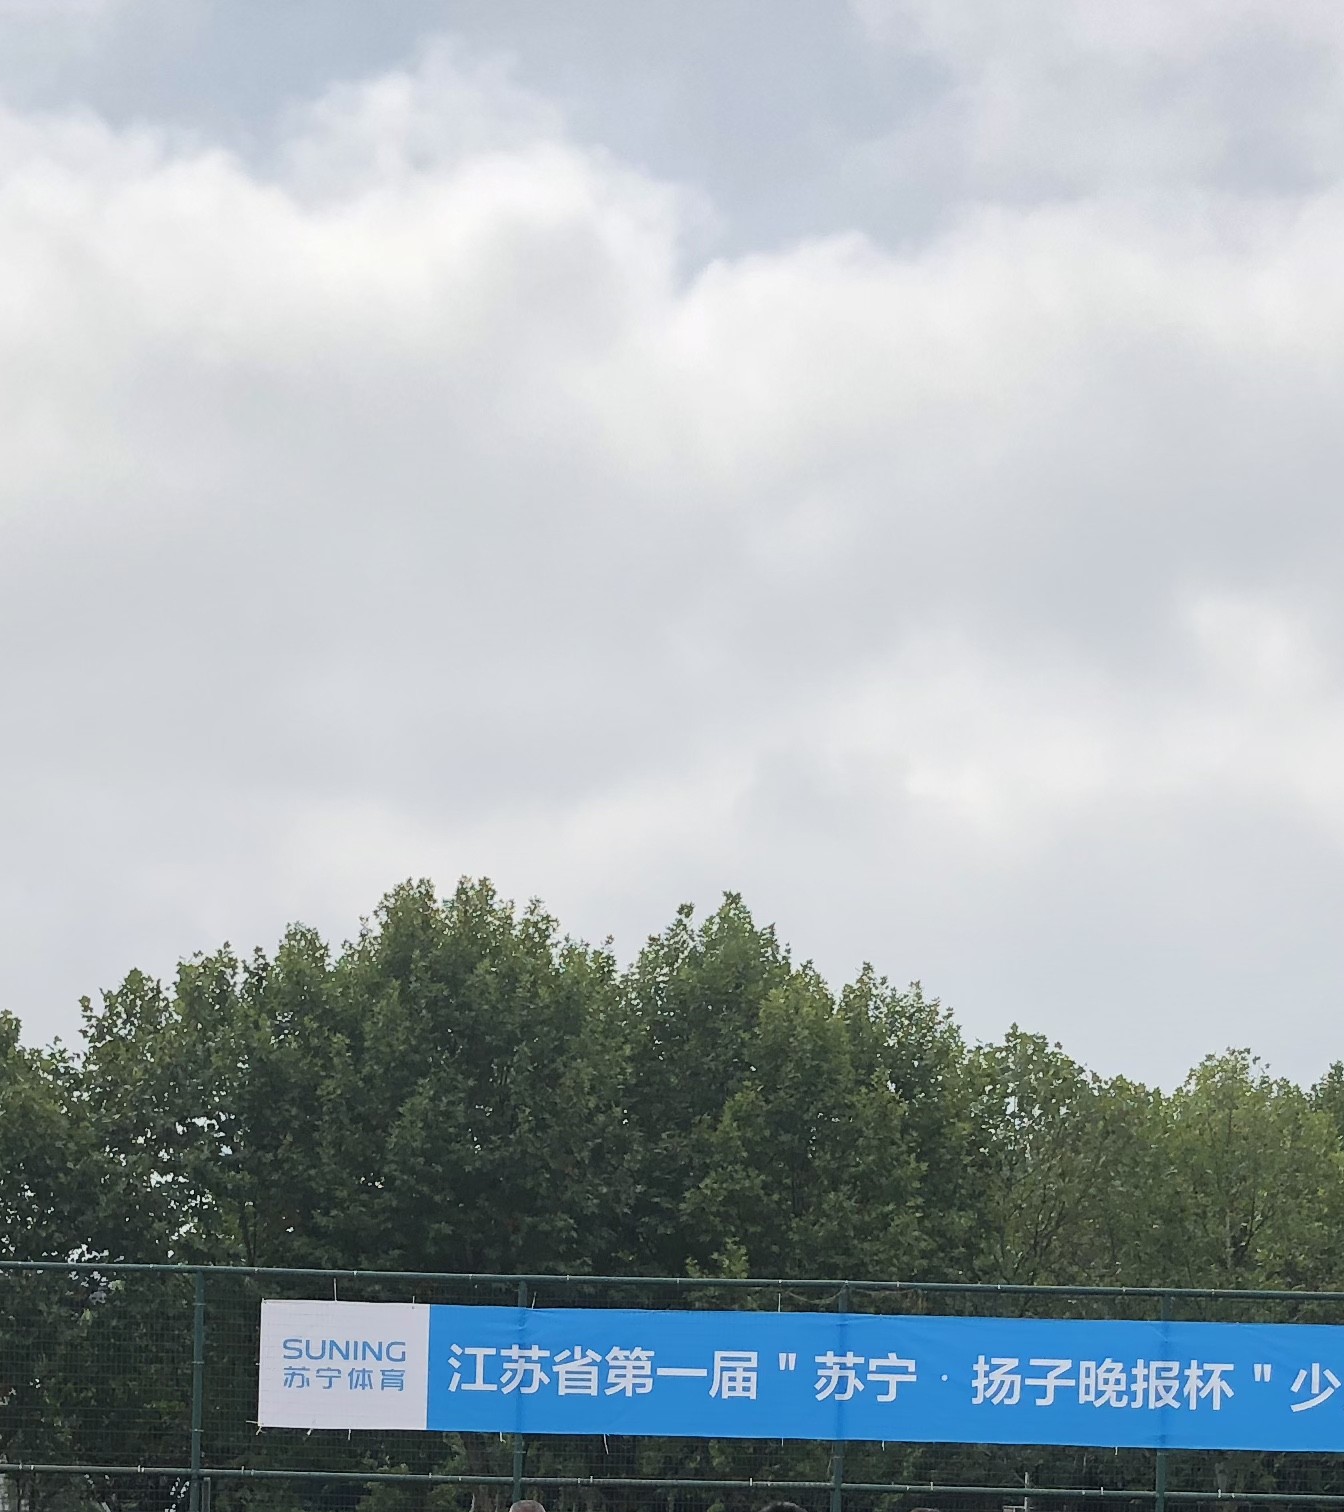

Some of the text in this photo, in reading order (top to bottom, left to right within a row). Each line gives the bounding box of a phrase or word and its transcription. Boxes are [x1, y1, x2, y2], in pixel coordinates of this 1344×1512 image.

[282, 1338, 407, 1363] SUNING
[282, 1366, 406, 1393] 苏宁体育
